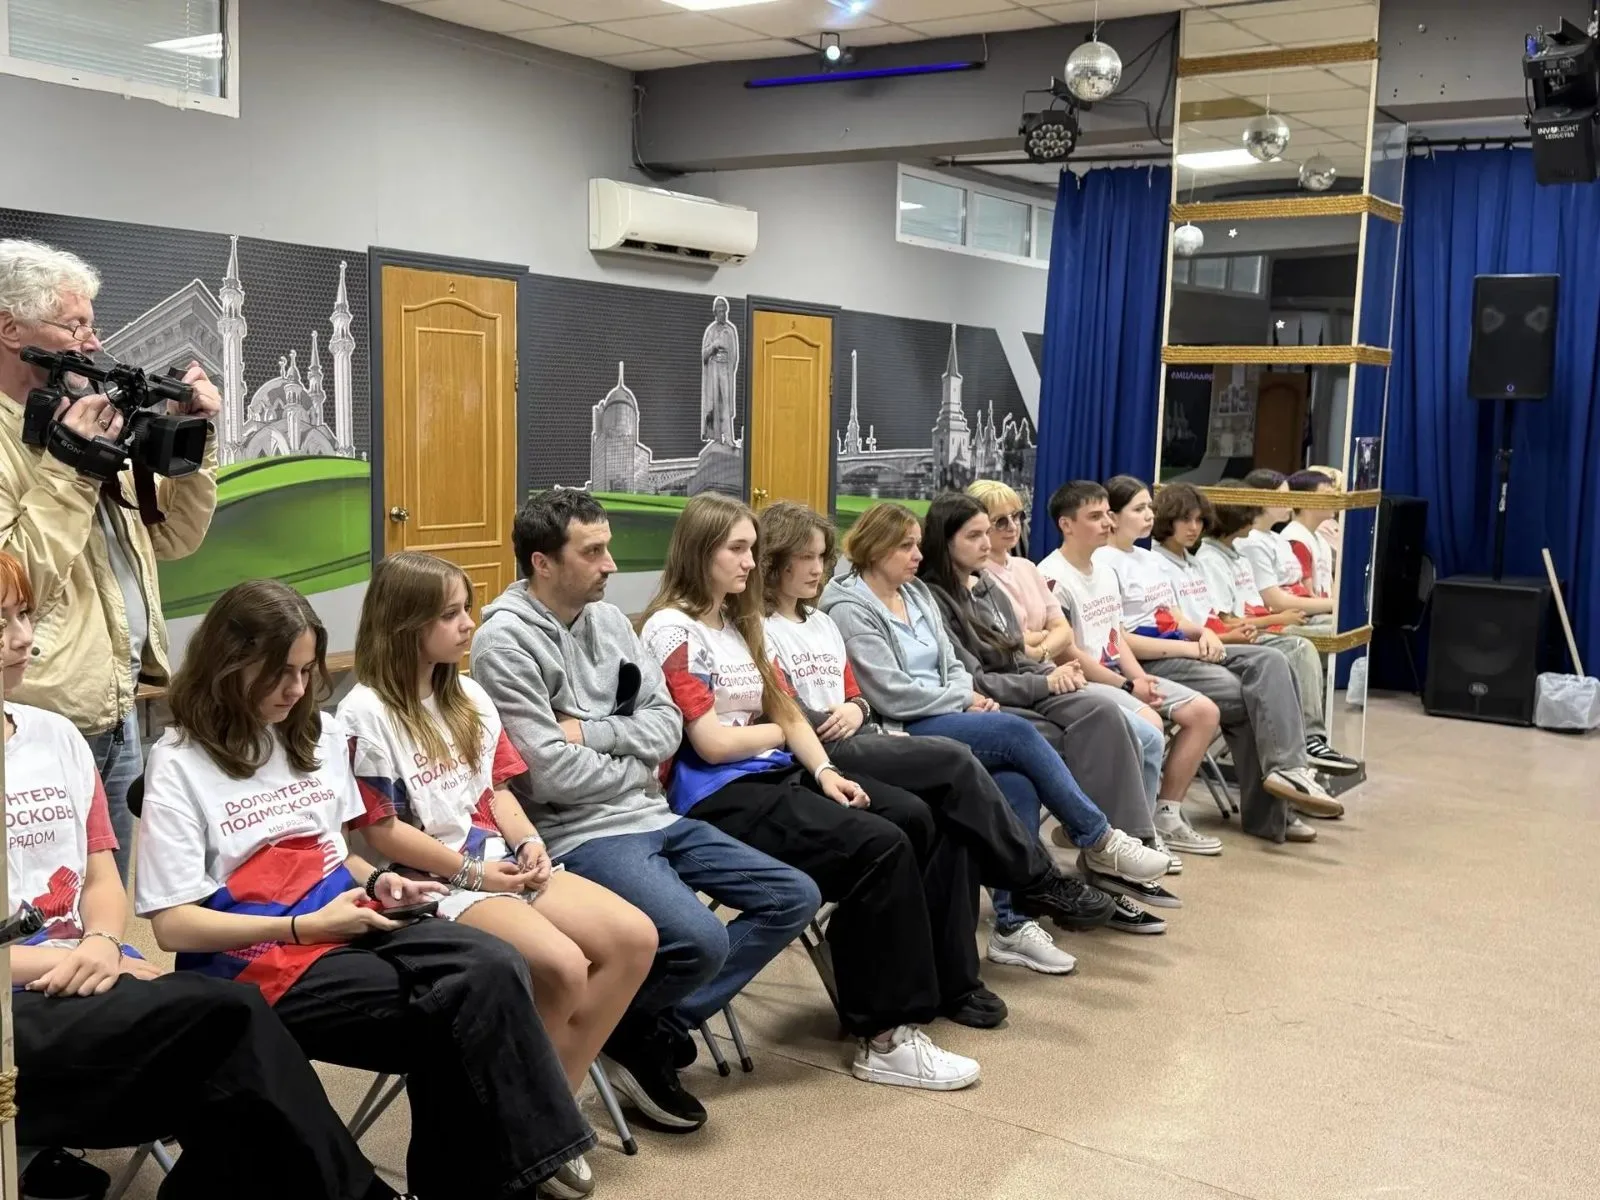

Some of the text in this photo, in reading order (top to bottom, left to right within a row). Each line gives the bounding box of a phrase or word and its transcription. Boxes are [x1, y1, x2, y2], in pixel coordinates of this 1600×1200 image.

[219, 789, 336, 837] ПОДМОСКОВЬЯ
[224, 778, 322, 817] ВОЛОНТЕРЫ
[5, 805, 74, 828] ОСКОВЬ
[9, 829, 56, 850] РЯДОМ
